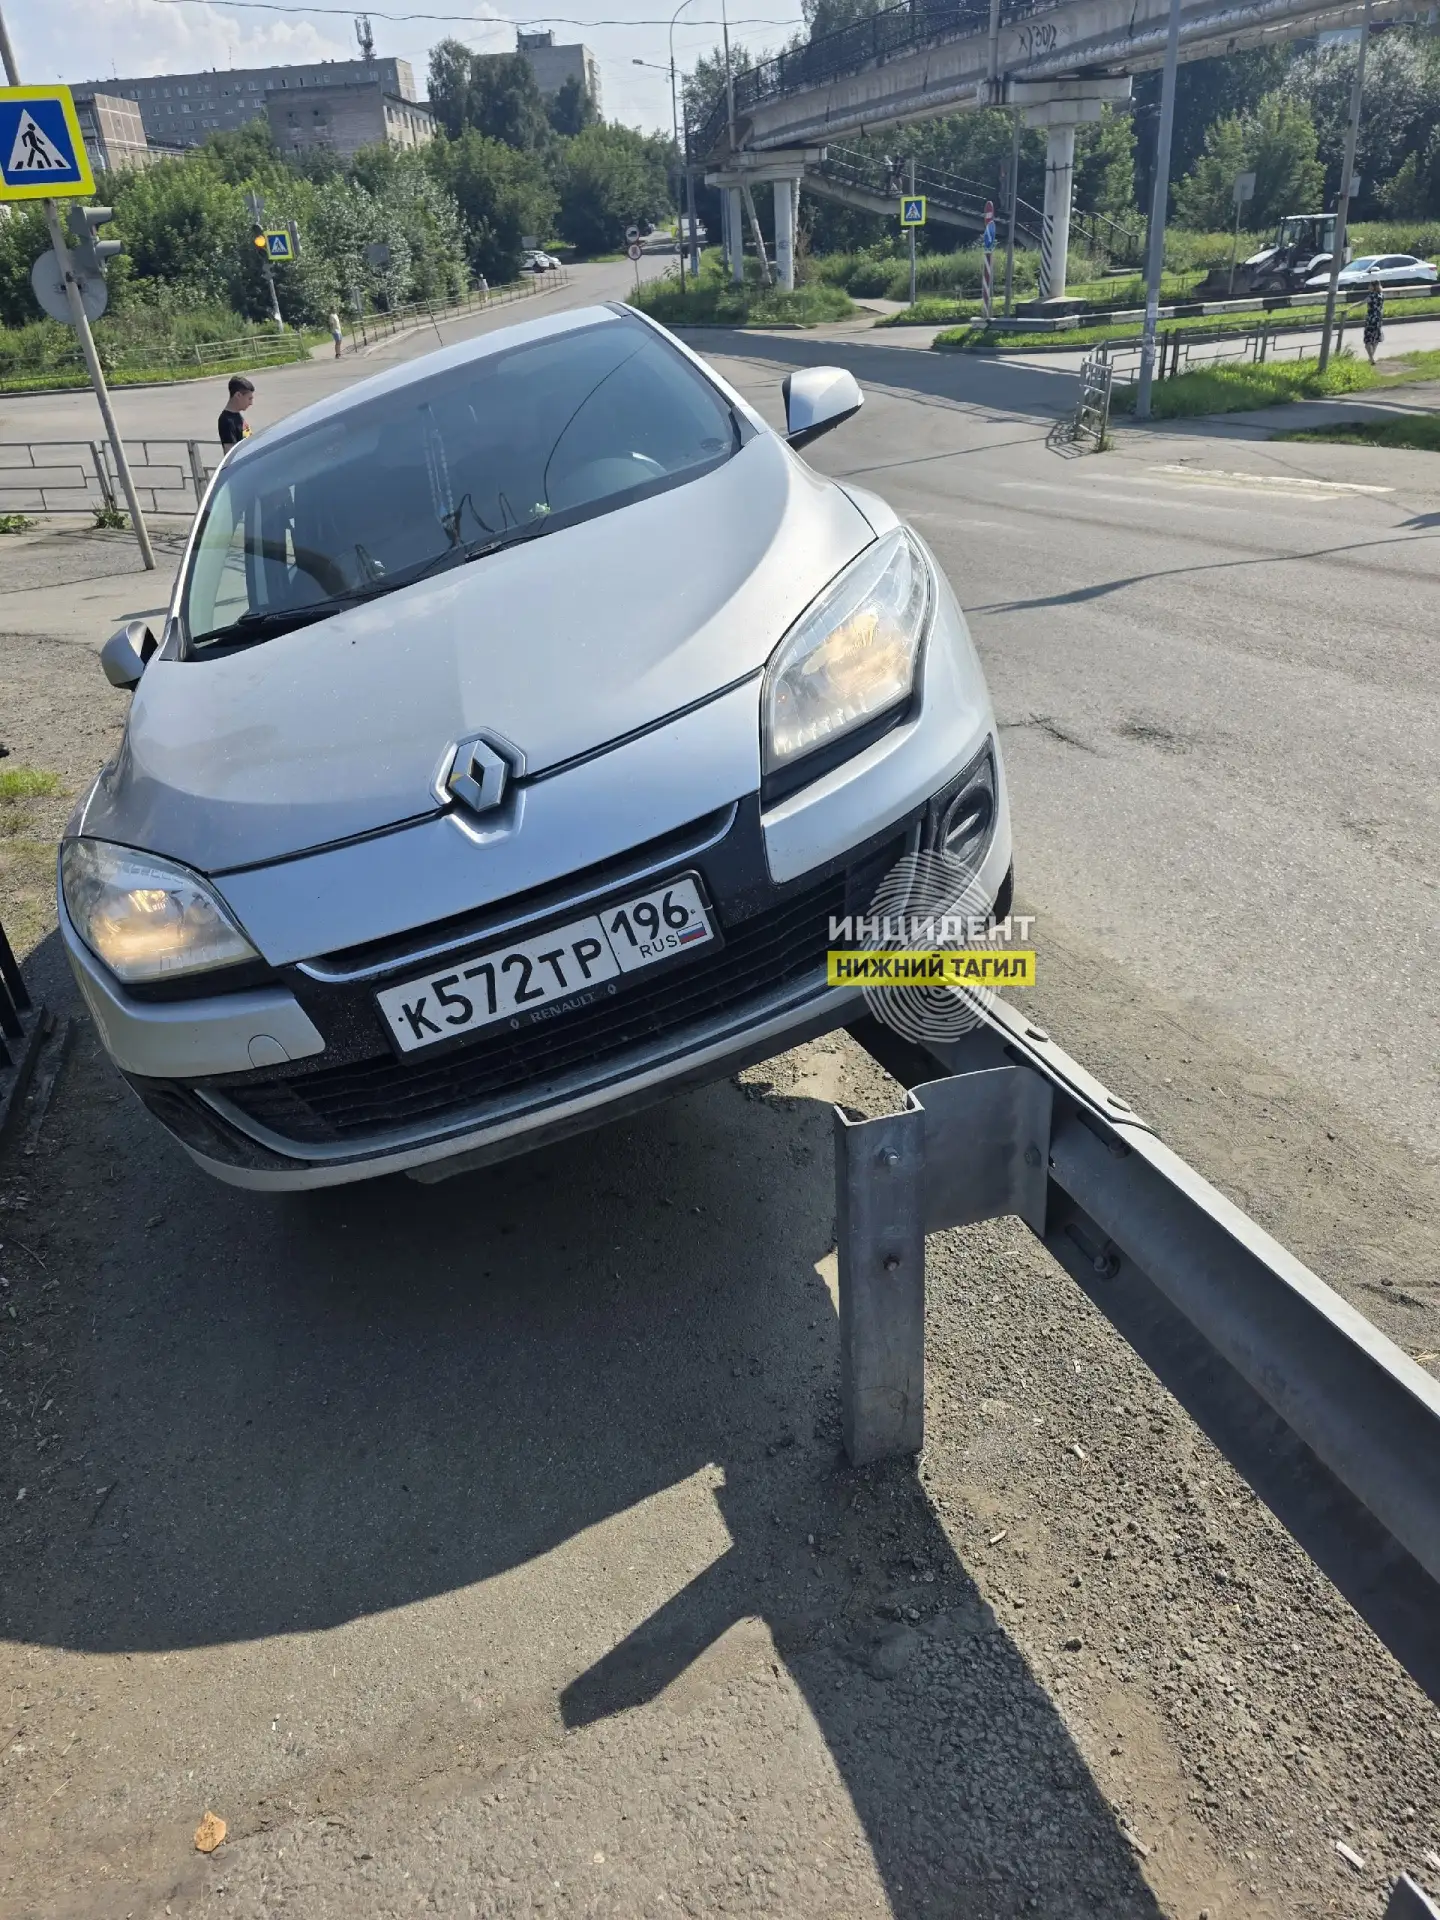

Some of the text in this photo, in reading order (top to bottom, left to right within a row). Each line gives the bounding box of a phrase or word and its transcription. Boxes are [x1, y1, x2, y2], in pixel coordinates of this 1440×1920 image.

[611, 890, 689, 947] 196
[640, 935, 677, 958] RUS
[530, 992, 596, 1024] RENAULT
